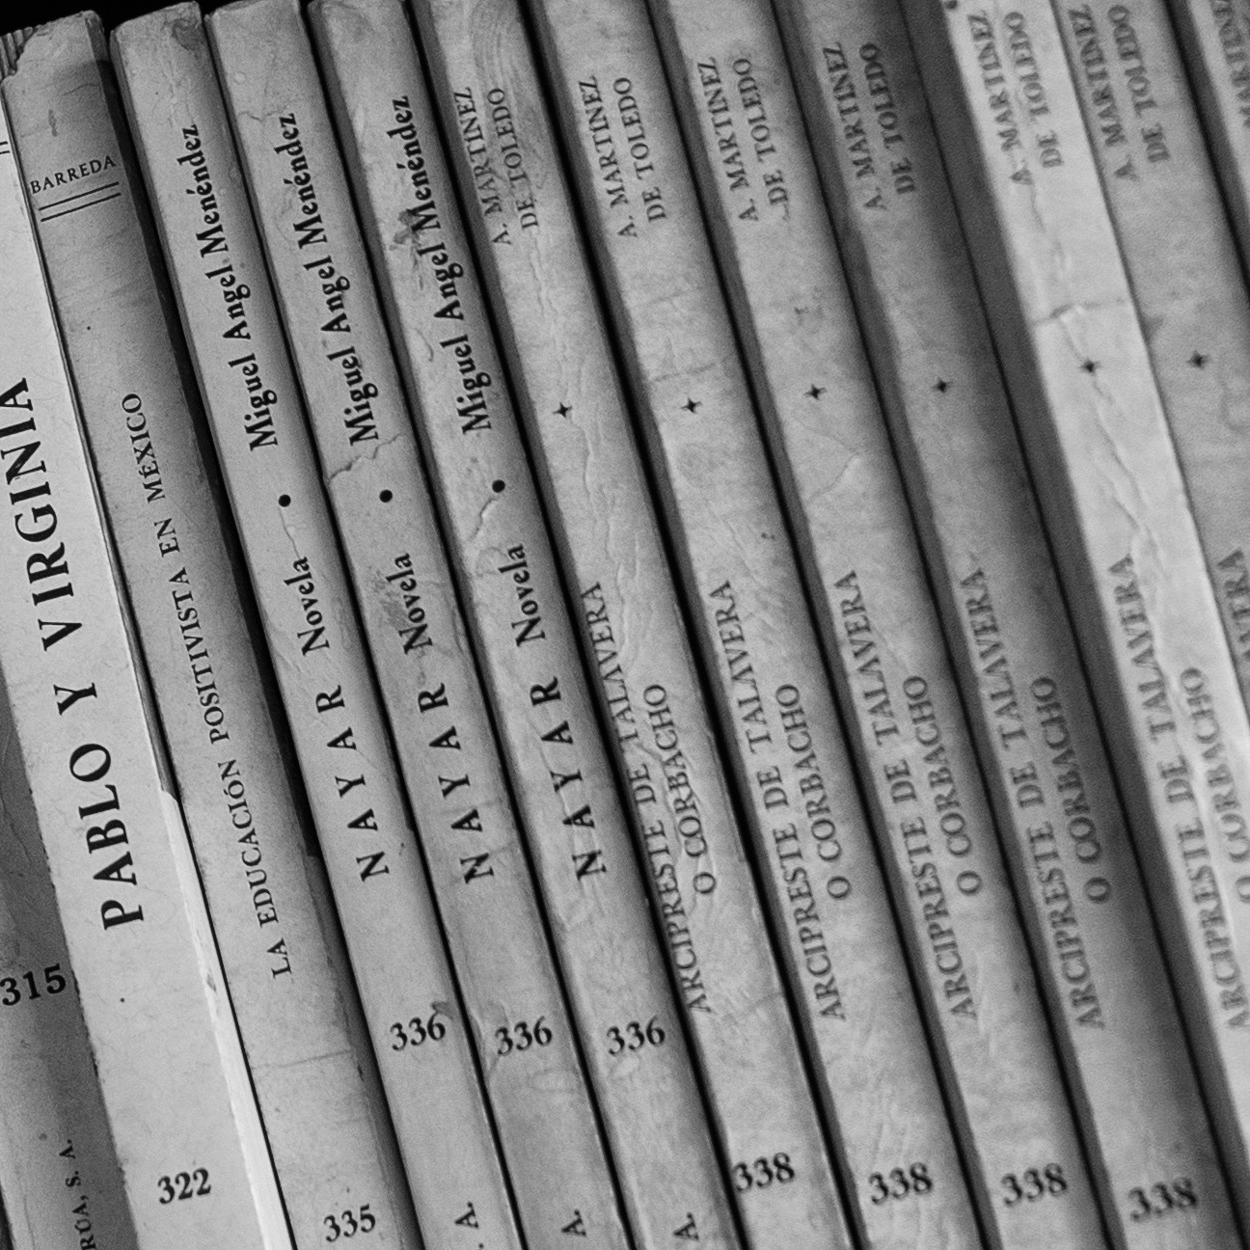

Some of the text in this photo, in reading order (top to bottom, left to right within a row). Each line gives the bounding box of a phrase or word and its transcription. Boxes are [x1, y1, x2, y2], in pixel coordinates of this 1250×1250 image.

[613, 78, 667, 224] DE TOLEDO
[30, 157, 116, 193] BARREDA
[176, 124, 278, 451] Miguel Angel Menéndez
[275, 112, 379, 446] Miguel Angel Menéndez
[283, 557, 330, 655] Novela
[386, 552, 432, 655] Novela
[53, 682, 98, 716] Y
[122, 394, 293, 978] LA EDUCACIÓN POSITIVISTA EN MÉXICO
[581, 583, 711, 1014] ARCIPRESTE DE TALAVERA
[643, 684, 717, 895] O CORBACHO
[68, 743, 144, 931] PABLO
[0, 964, 67, 1007] 315
[390, 1014, 446, 1051] 336
[495, 1016, 552, 1057] 336
[159, 1168, 212, 1204] 322
[732, 1153, 795, 1194] 338
[869, 1164, 933, 1205] 338
[1001, 1164, 1067, 1206] 338
[324, 1206, 376, 1243] 335
